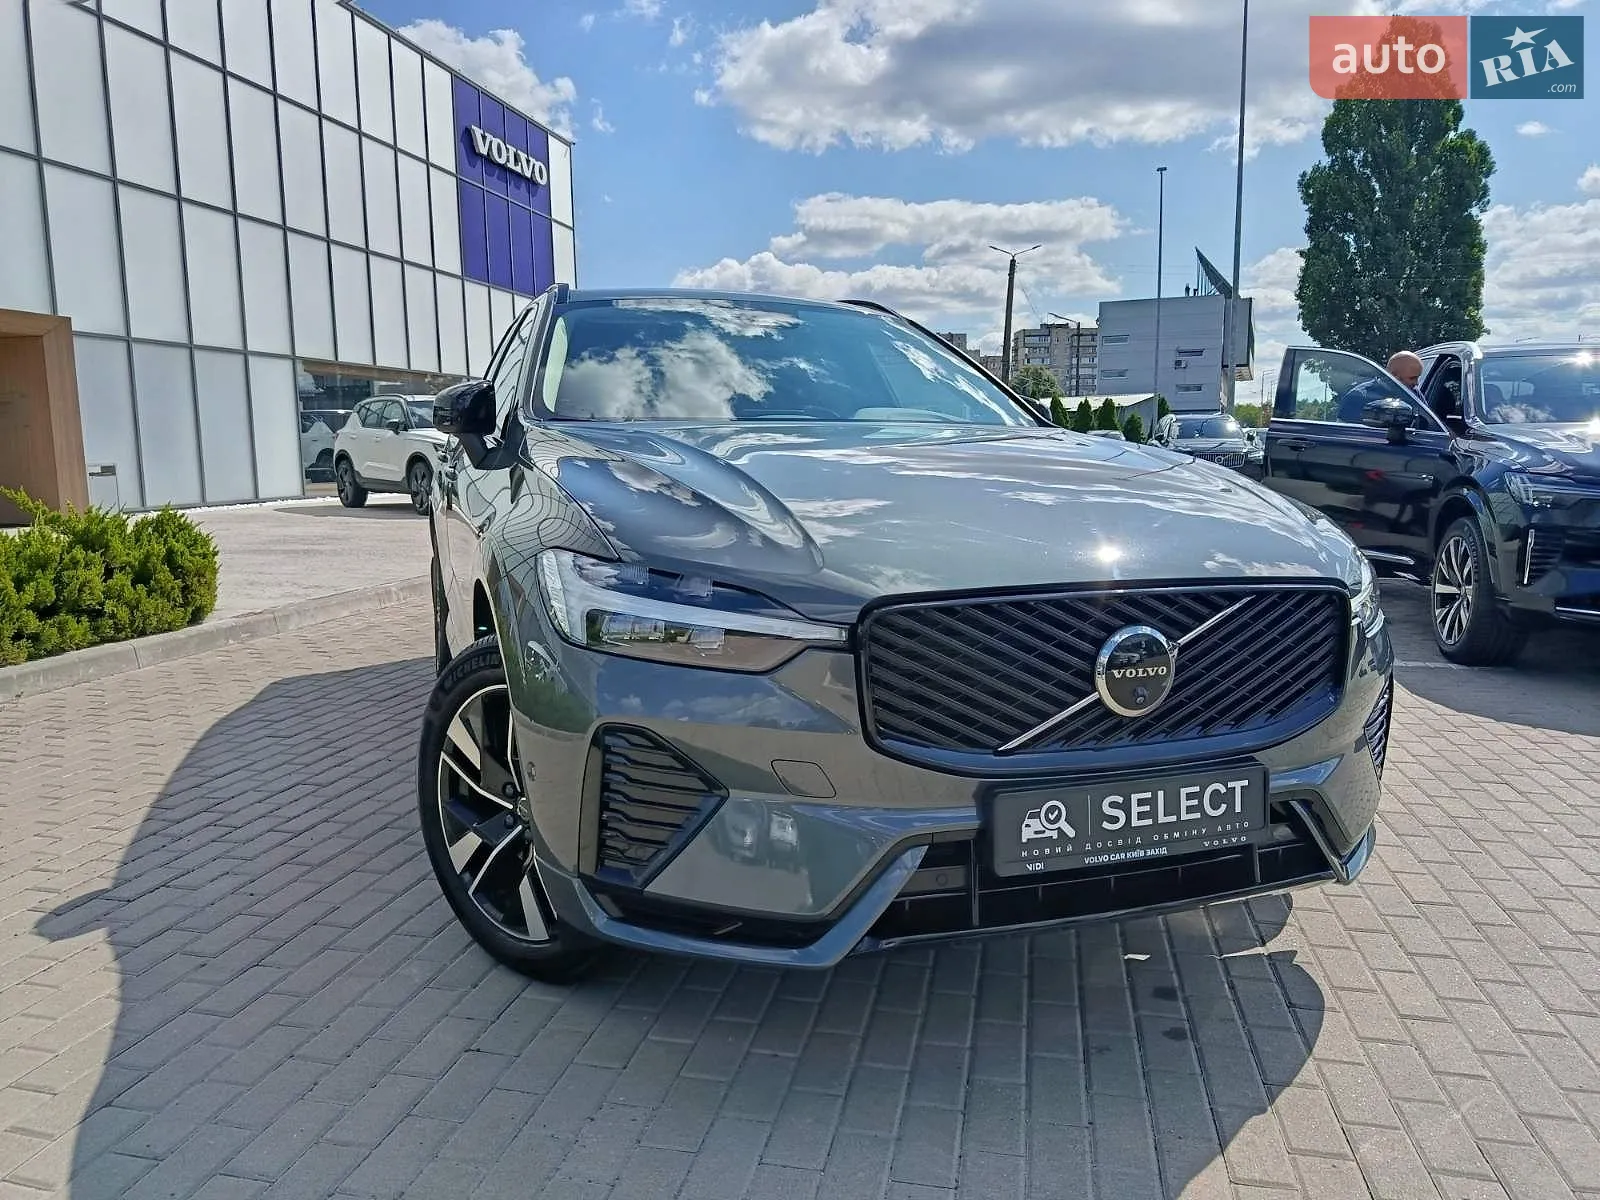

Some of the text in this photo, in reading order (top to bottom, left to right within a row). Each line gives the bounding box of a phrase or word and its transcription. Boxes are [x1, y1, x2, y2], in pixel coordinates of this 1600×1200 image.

[471, 124, 548, 186] VOLVO
[1112, 666, 1167, 679] VOLVO
[1101, 779, 1249, 831] SELECT
[1021, 821, 1249, 858] НОВИЙ ДОСВІД ОБМІНУ АВТО
[1203, 835, 1247, 847] VOLVO
[1084, 846, 1168, 865] VOLVO CAR КИЇВ ЗАХІД
